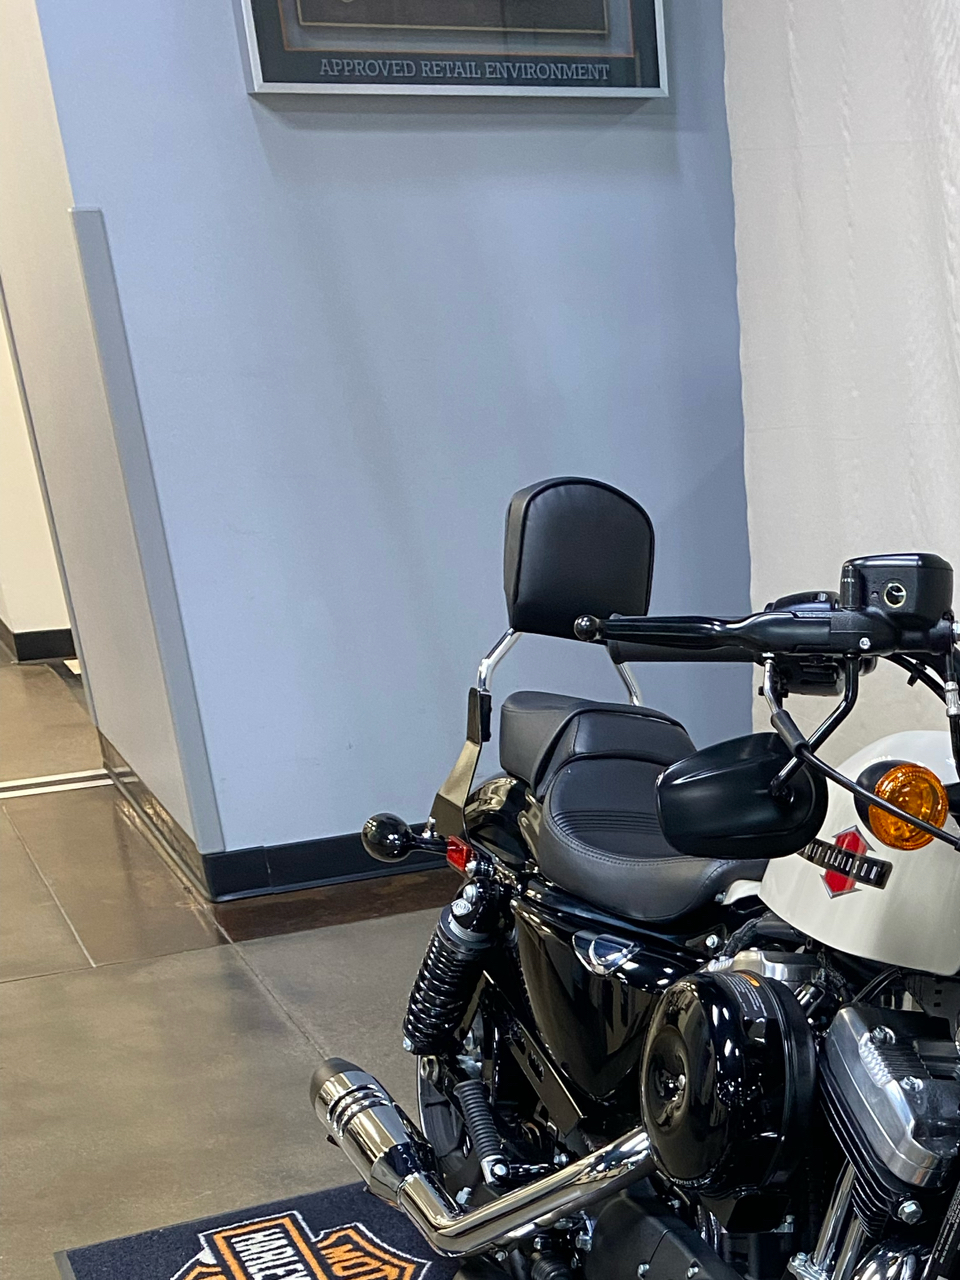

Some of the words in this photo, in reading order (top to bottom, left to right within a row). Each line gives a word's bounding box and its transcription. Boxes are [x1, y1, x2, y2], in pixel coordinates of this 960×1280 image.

[320, 59, 416, 77] APPROVED
[421, 60, 481, 78] RETAIL
[485, 63, 610, 81] ENVIRONMENT
